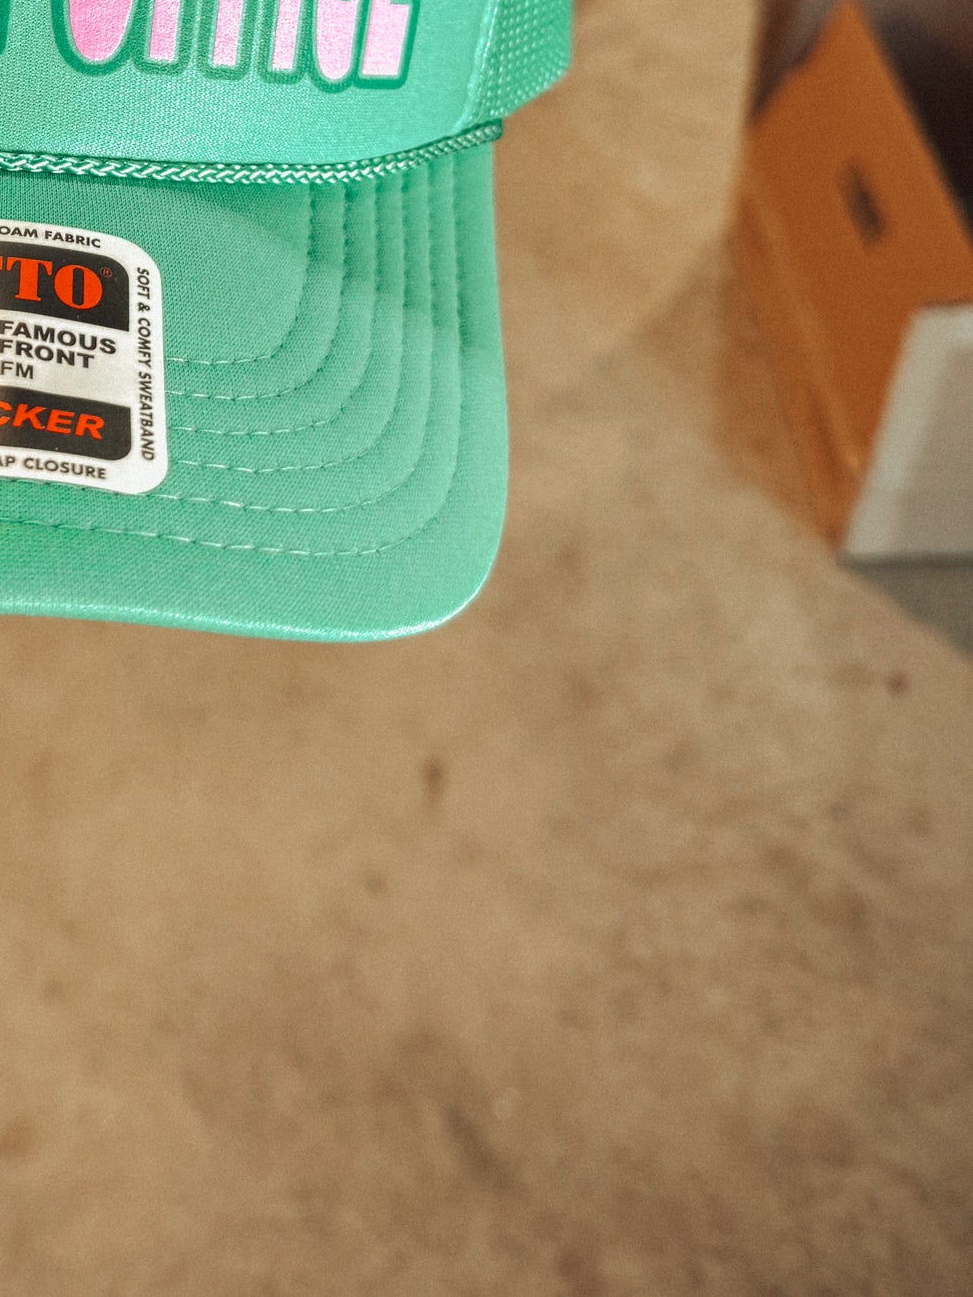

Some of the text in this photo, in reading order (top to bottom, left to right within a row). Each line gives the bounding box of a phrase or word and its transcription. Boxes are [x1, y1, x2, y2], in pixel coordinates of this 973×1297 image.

[44, 230, 102, 249] FABRIC
[136, 266, 155, 462] SOFT & COMFY SWEATBAND
[22, 457, 107, 480] CLOSURE
